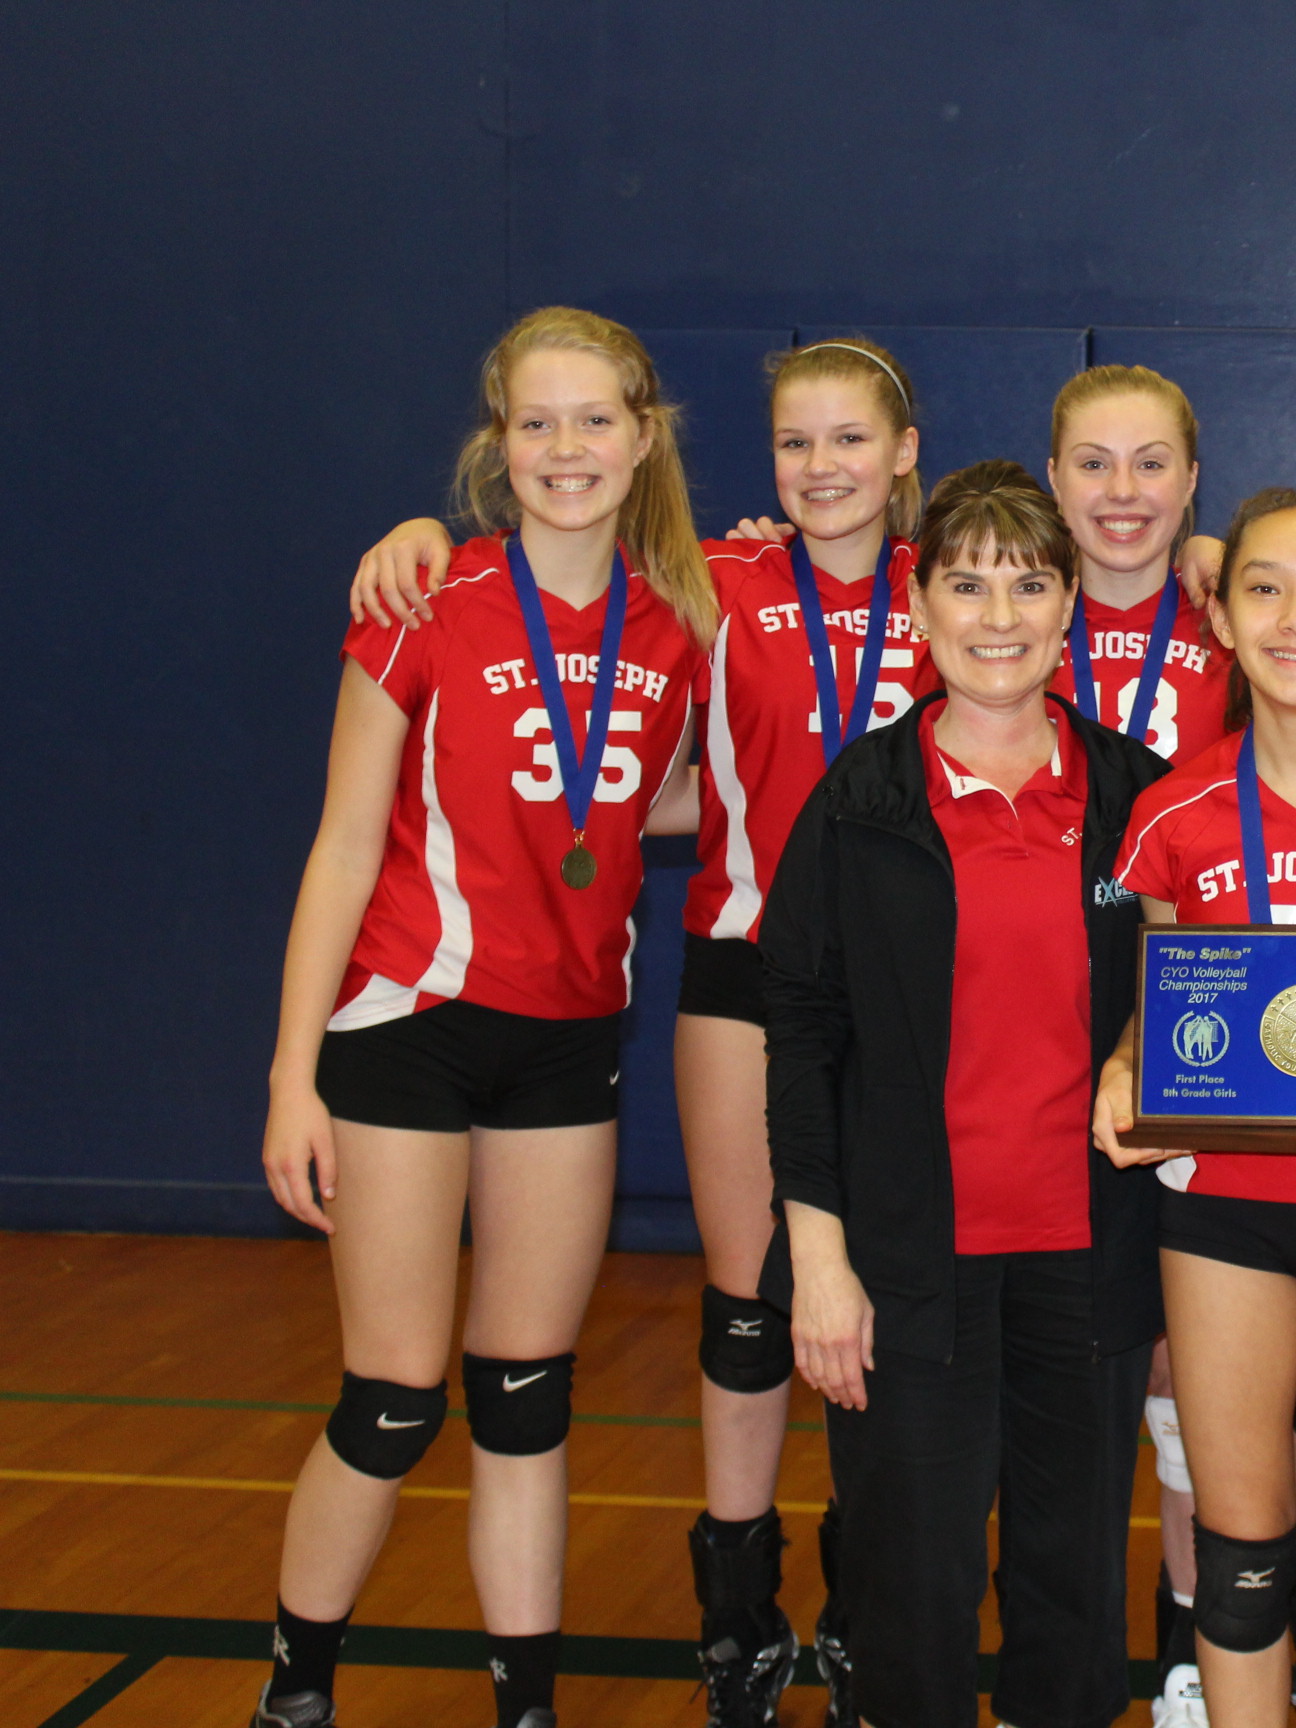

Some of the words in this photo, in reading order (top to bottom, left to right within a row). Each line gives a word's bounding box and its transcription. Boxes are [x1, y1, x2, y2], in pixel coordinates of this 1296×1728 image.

[1088, 631, 1211, 674] JOSPH
[482, 658, 538, 695] ST.
[510, 707, 643, 803] 35
[1197, 859, 1248, 903] ST.
[1159, 947, 1196, 960] "The
[1199, 947, 1252, 962] Spike"
[1161, 966, 1190, 979] CYO
[1193, 966, 1247, 981] Volleyball
[1159, 980, 1248, 993] Championships
[1187, 992, 1219, 1004] 2017
[1175, 1074, 1197, 1084] First
[1199, 1074, 1225, 1084] Place
[1163, 1087, 1179, 1098] 8th
[1181, 1087, 1211, 1098] Grade
[1213, 1087, 1238, 1098] Girls
